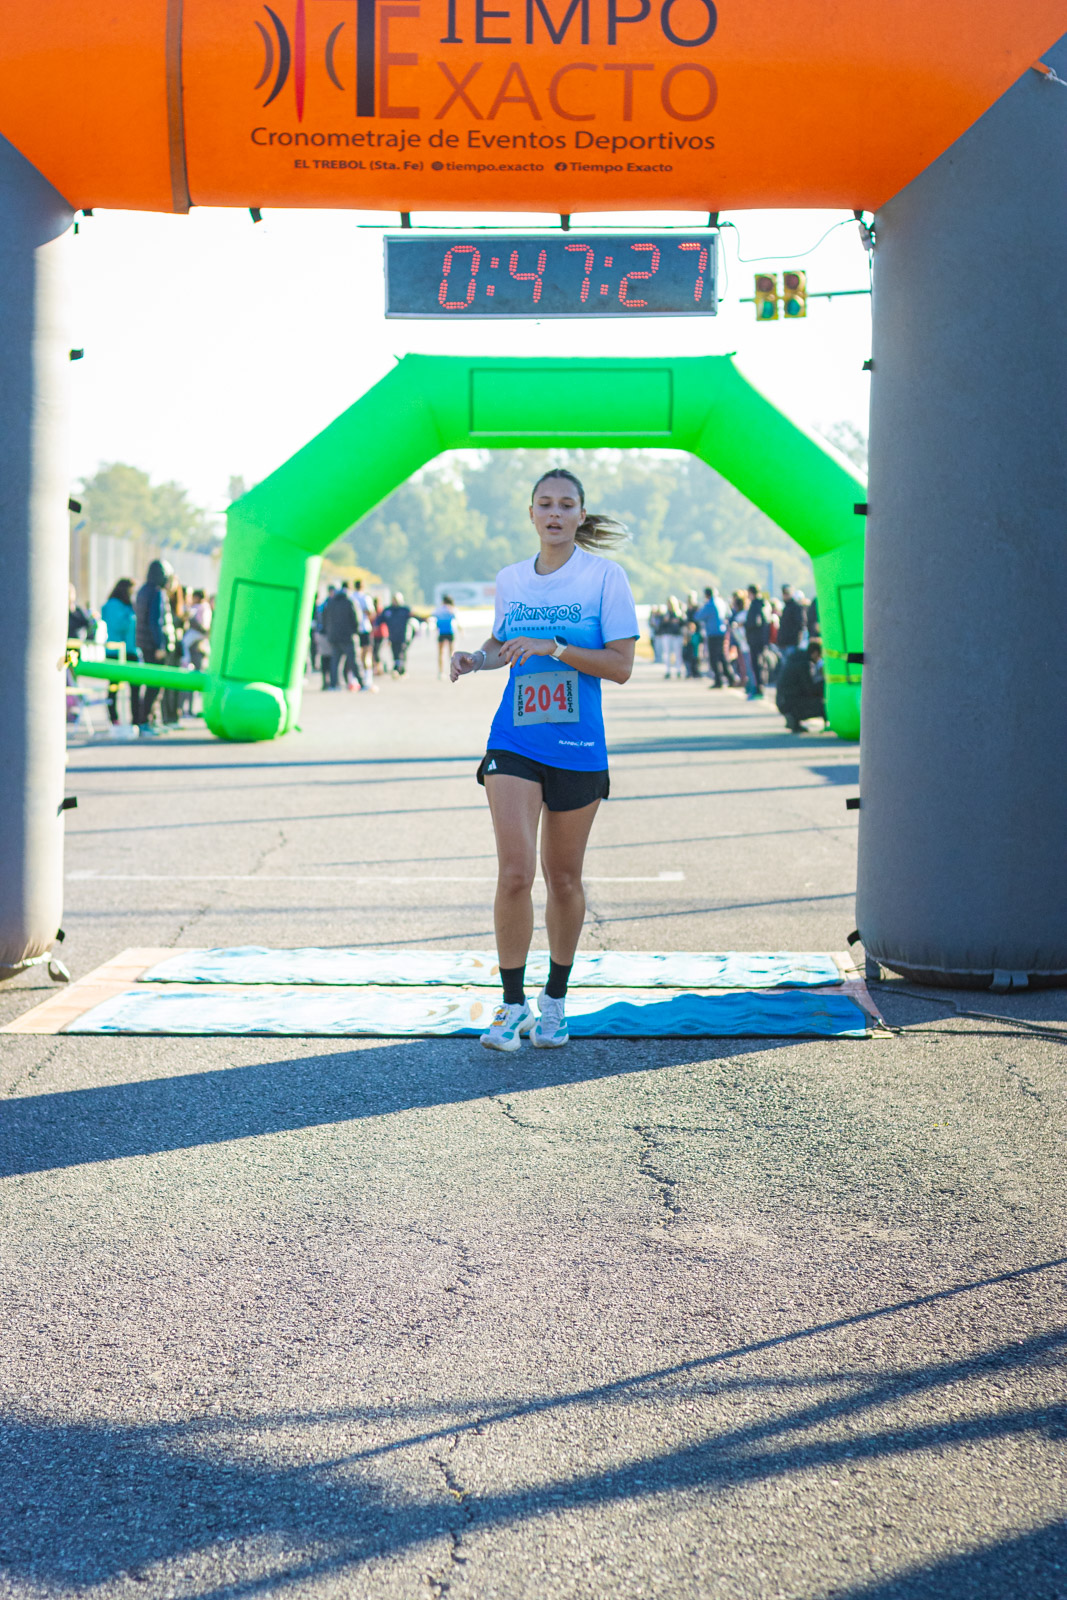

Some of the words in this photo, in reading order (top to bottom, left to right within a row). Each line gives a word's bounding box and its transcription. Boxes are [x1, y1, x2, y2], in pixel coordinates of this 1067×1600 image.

[250, 126, 421, 151] Cronometraje
[428, 129, 460, 148] de
[467, 130, 567, 149] Eventos
[574, 131, 716, 153] Deportivos
[293, 159, 310, 169] EL
[313, 159, 366, 170] TREBOL
[369, 160, 401, 171] (Sta.
[403, 161, 424, 171] Fe)
[569, 162, 623, 173] Tiempo
[626, 163, 673, 173] Exacto
[524, 683, 567, 713] 204
[566, 680, 574, 713] EXACTO
